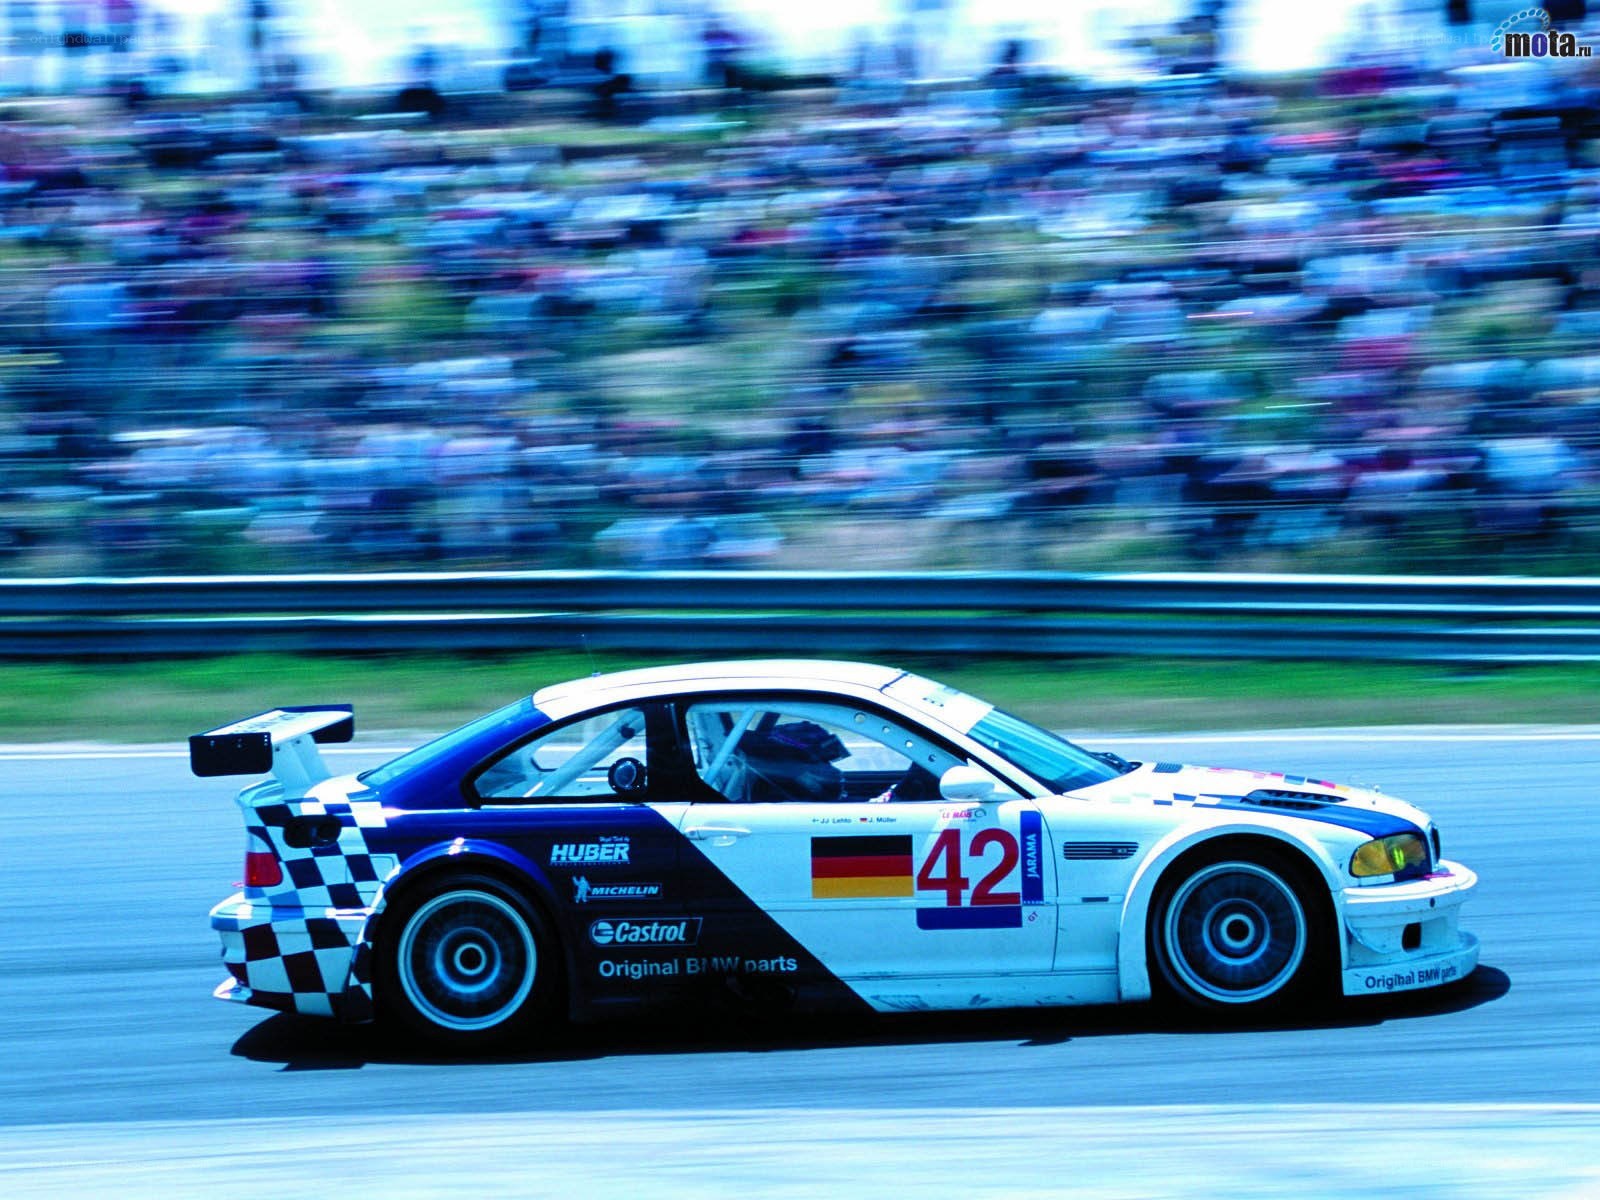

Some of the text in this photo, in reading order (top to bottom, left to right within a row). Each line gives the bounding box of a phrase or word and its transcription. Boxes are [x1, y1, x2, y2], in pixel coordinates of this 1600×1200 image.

[551, 843, 630, 862] HUBER
[1026, 833, 1040, 878] JARAMA
[917, 828, 1021, 907] 42
[591, 886, 659, 895] MICHELIN
[1028, 911, 1039, 922] GT
[615, 922, 687, 943] Castrol
[599, 959, 679, 979] Original
[744, 956, 798, 974] parts
[1418, 968, 1440, 983] BMW
[1441, 966, 1456, 981] parts
